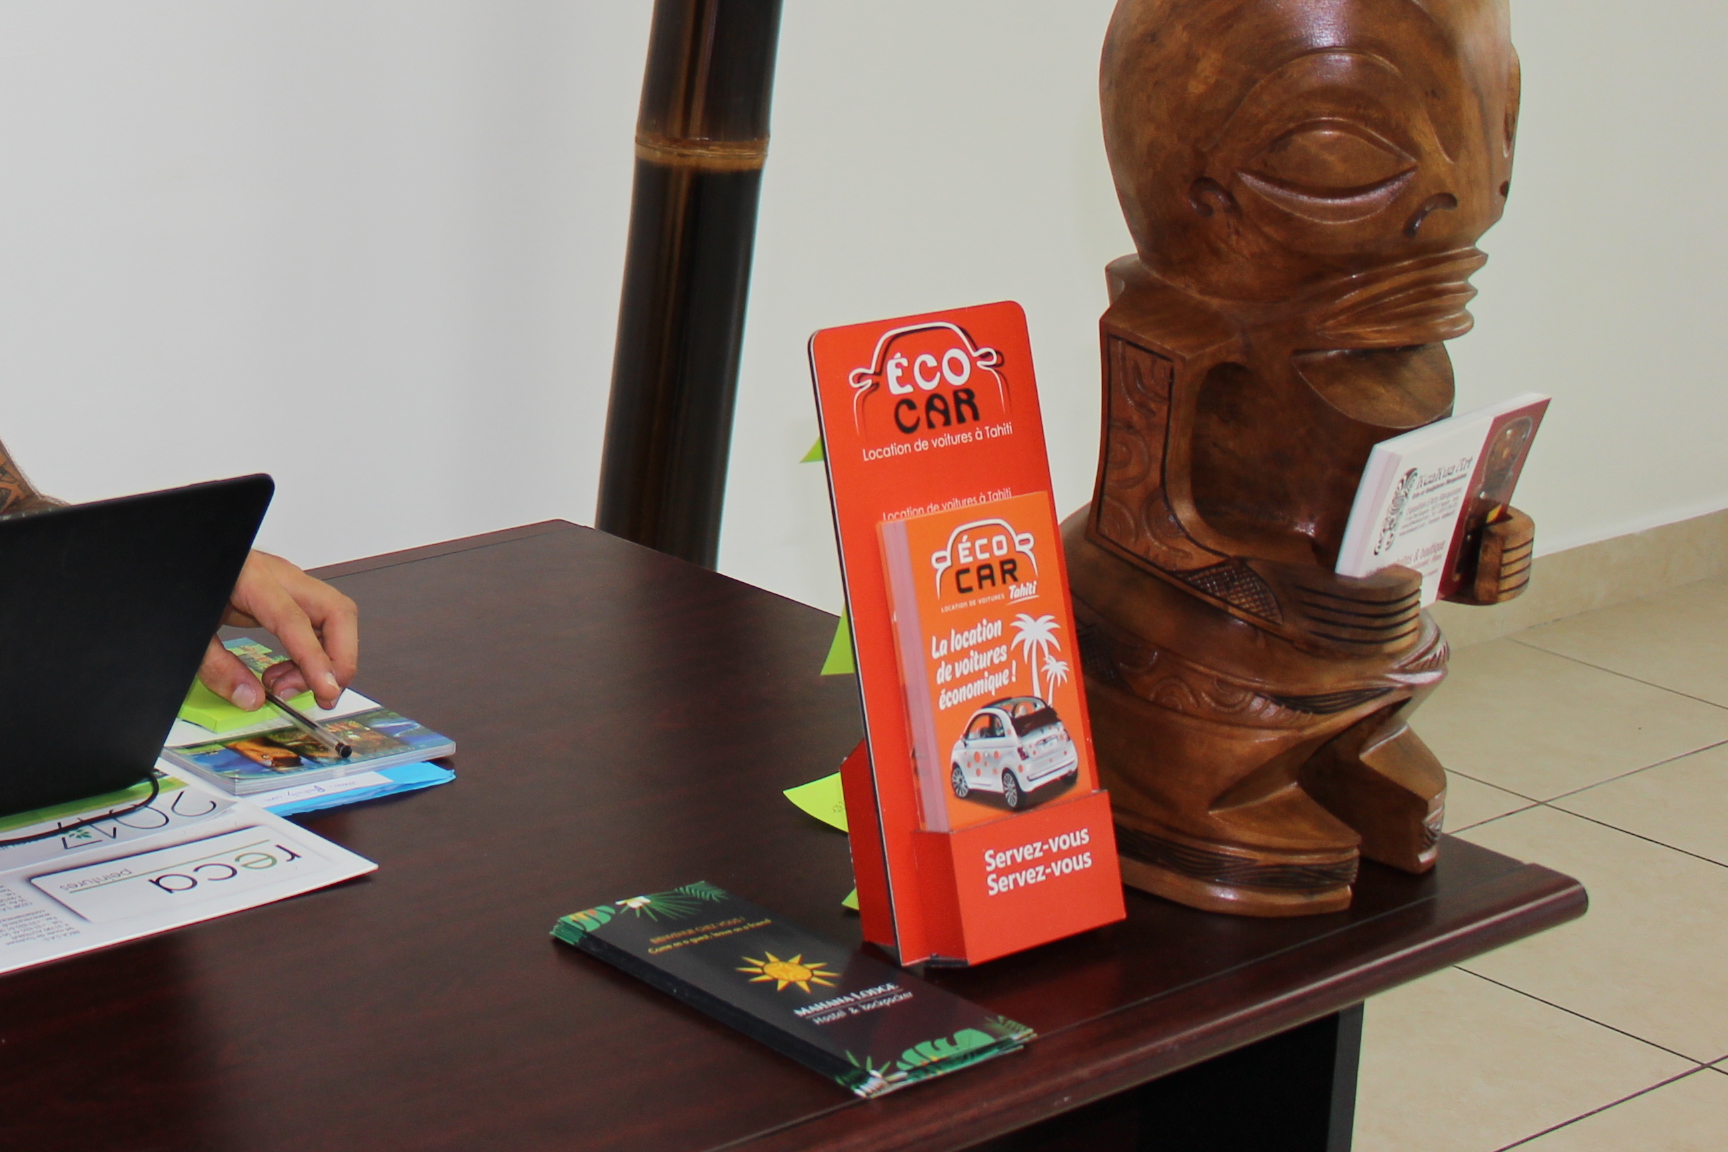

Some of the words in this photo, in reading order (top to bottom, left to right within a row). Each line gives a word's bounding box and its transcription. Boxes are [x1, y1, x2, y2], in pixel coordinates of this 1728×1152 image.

[886, 348, 971, 395] ÉCO
[894, 387, 980, 434] CAR
[862, 442, 912, 462] Location
[914, 439, 929, 451] de
[931, 432, 973, 448] voitures
[975, 428, 983, 441] à
[985, 422, 1013, 438] Tahiti
[926, 501, 940, 513] de
[987, 488, 1012, 502] Tahiti
[958, 535, 1008, 564] ÉCO
[955, 558, 1019, 594] CAR
[941, 602, 968, 613] LOCATION
[969, 599, 977, 607] DE
[977, 593, 1005, 605] VOITURES
[1009, 580, 1037, 600] Tahiti
[931, 635, 948, 659] La
[950, 619, 1003, 653] location
[936, 660, 952, 685] de
[955, 645, 1008, 679] voitures
[939, 670, 1010, 711] économique
[1011, 660, 1017, 682] !
[148, 845, 302, 894] reca
[984, 827, 1091, 872] Servez-vous
[59, 867, 133, 892] peintures
[986, 851, 1093, 896] Servez-vous
